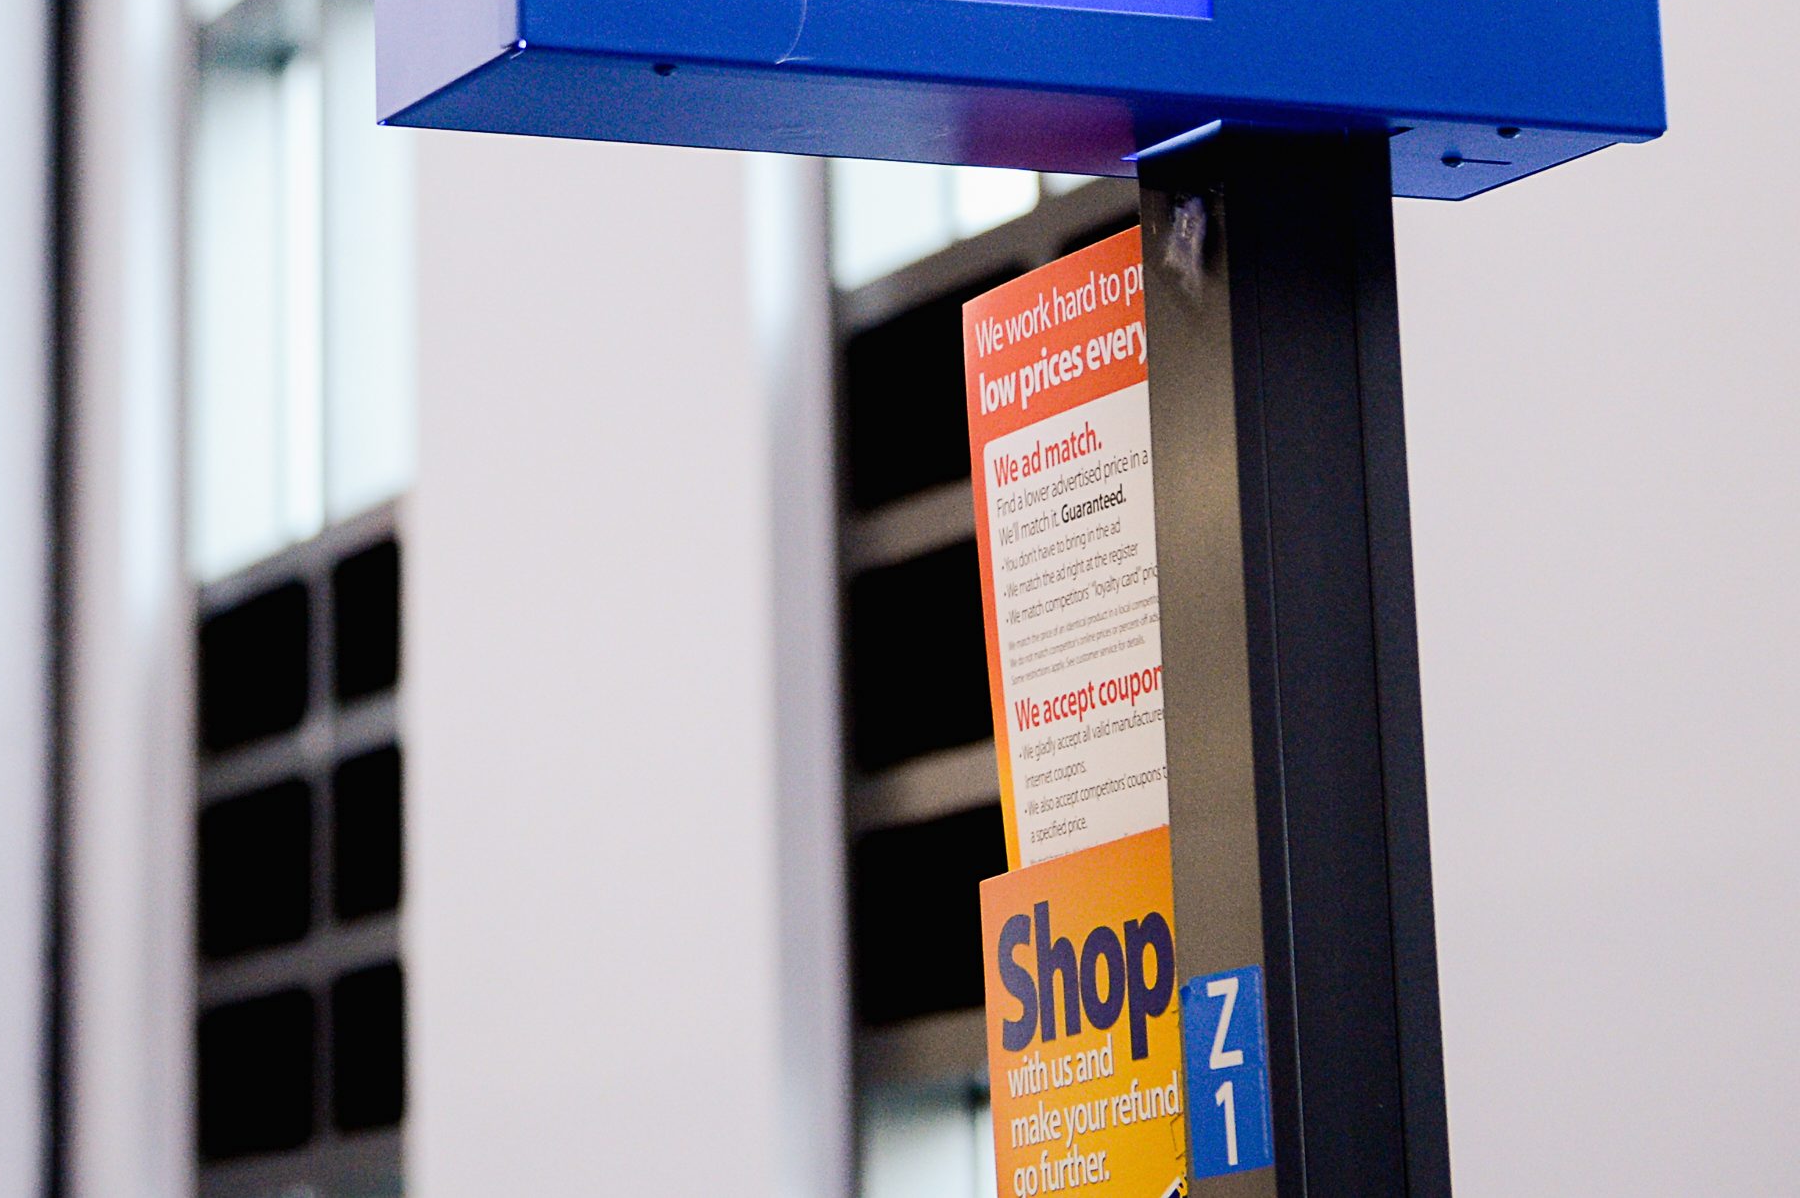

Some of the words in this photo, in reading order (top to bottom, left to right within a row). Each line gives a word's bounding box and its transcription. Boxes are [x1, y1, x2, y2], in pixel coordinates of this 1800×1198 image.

[975, 316, 1004, 358] We
[1005, 293, 1051, 345] work
[1053, 270, 1096, 326] hard
[1099, 273, 1121, 306] to
[979, 372, 1016, 415] low
[1019, 347, 1084, 410] prices
[1086, 321, 1147, 371] every
[994, 453, 1019, 488] We
[1022, 440, 1042, 478] ad
[1044, 421, 1102, 470] match.
[996, 492, 1016, 517] Find
[1017, 495, 1023, 510] a
[1023, 484, 1050, 507] lower
[1051, 459, 1102, 498] advertised
[1102, 455, 1128, 483] price
[1129, 449, 1140, 469] in
[1141, 449, 1148, 465] a
[1020, 510, 1050, 538] match
[1060, 482, 1126, 523] Guaranteed.
[1055, 540, 1065, 553] to
[1065, 532, 1086, 550] bring
[1086, 527, 1095, 543] in
[1095, 523, 1109, 540] the
[1109, 517, 1121, 535] ad
[1018, 572, 1042, 593] match
[1041, 569, 1055, 586] the
[1055, 563, 1065, 582] ad
[1066, 559, 1085, 581] right
[1085, 556, 1094, 572] at
[1093, 552, 1107, 568] the
[1108, 542, 1138, 566] register
[1014, 696, 1040, 732] We
[1042, 680, 1096, 724] accept
[1056, 730, 1082, 750] accept
[1091, 719, 1110, 738] valid
[1039, 796, 1054, 813] also
[1054, 789, 1079, 809] accept
[1126, 767, 1161, 788] coupons
[1035, 817, 1067, 842] specified
[997, 900, 1175, 1060] Shop
[1206, 977, 1243, 1070] Z
[1007, 1051, 1049, 1098] with
[1051, 1056, 1073, 1089] us
[1076, 1034, 1114, 1082] and
[1010, 1096, 1062, 1149] make
[1064, 1099, 1110, 1148] your
[1111, 1071, 1182, 1128] refund
[1215, 1081, 1238, 1166] 1
[1012, 1164, 1039, 1198] go
[1040, 1144, 1111, 1195] further.
